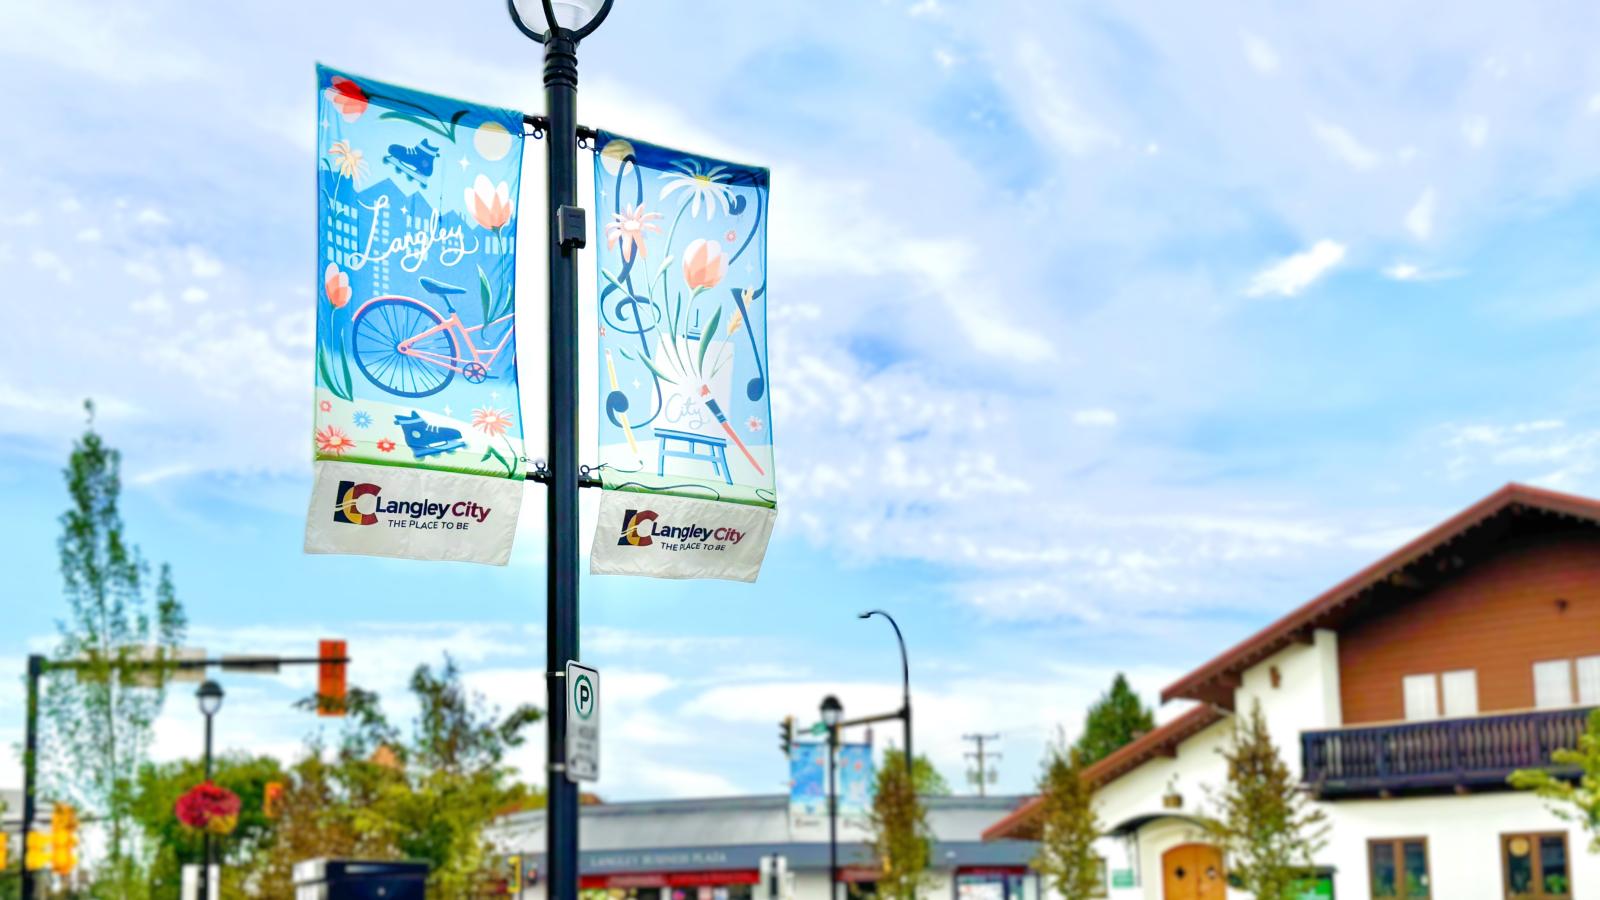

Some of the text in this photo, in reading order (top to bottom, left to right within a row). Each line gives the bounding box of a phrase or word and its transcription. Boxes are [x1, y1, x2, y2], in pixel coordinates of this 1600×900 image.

[349, 195, 479, 272] Langley
[665, 393, 711, 430] City
[375, 496, 491, 523] Langley City
[388, 519, 469, 530] THE PLACE TO BE
[651, 521, 746, 545] Langley City
[660, 542, 678, 551] THE
[679, 542, 700, 551] PLACE
[703, 543, 714, 551] TO
[580, 684, 590, 710] P
